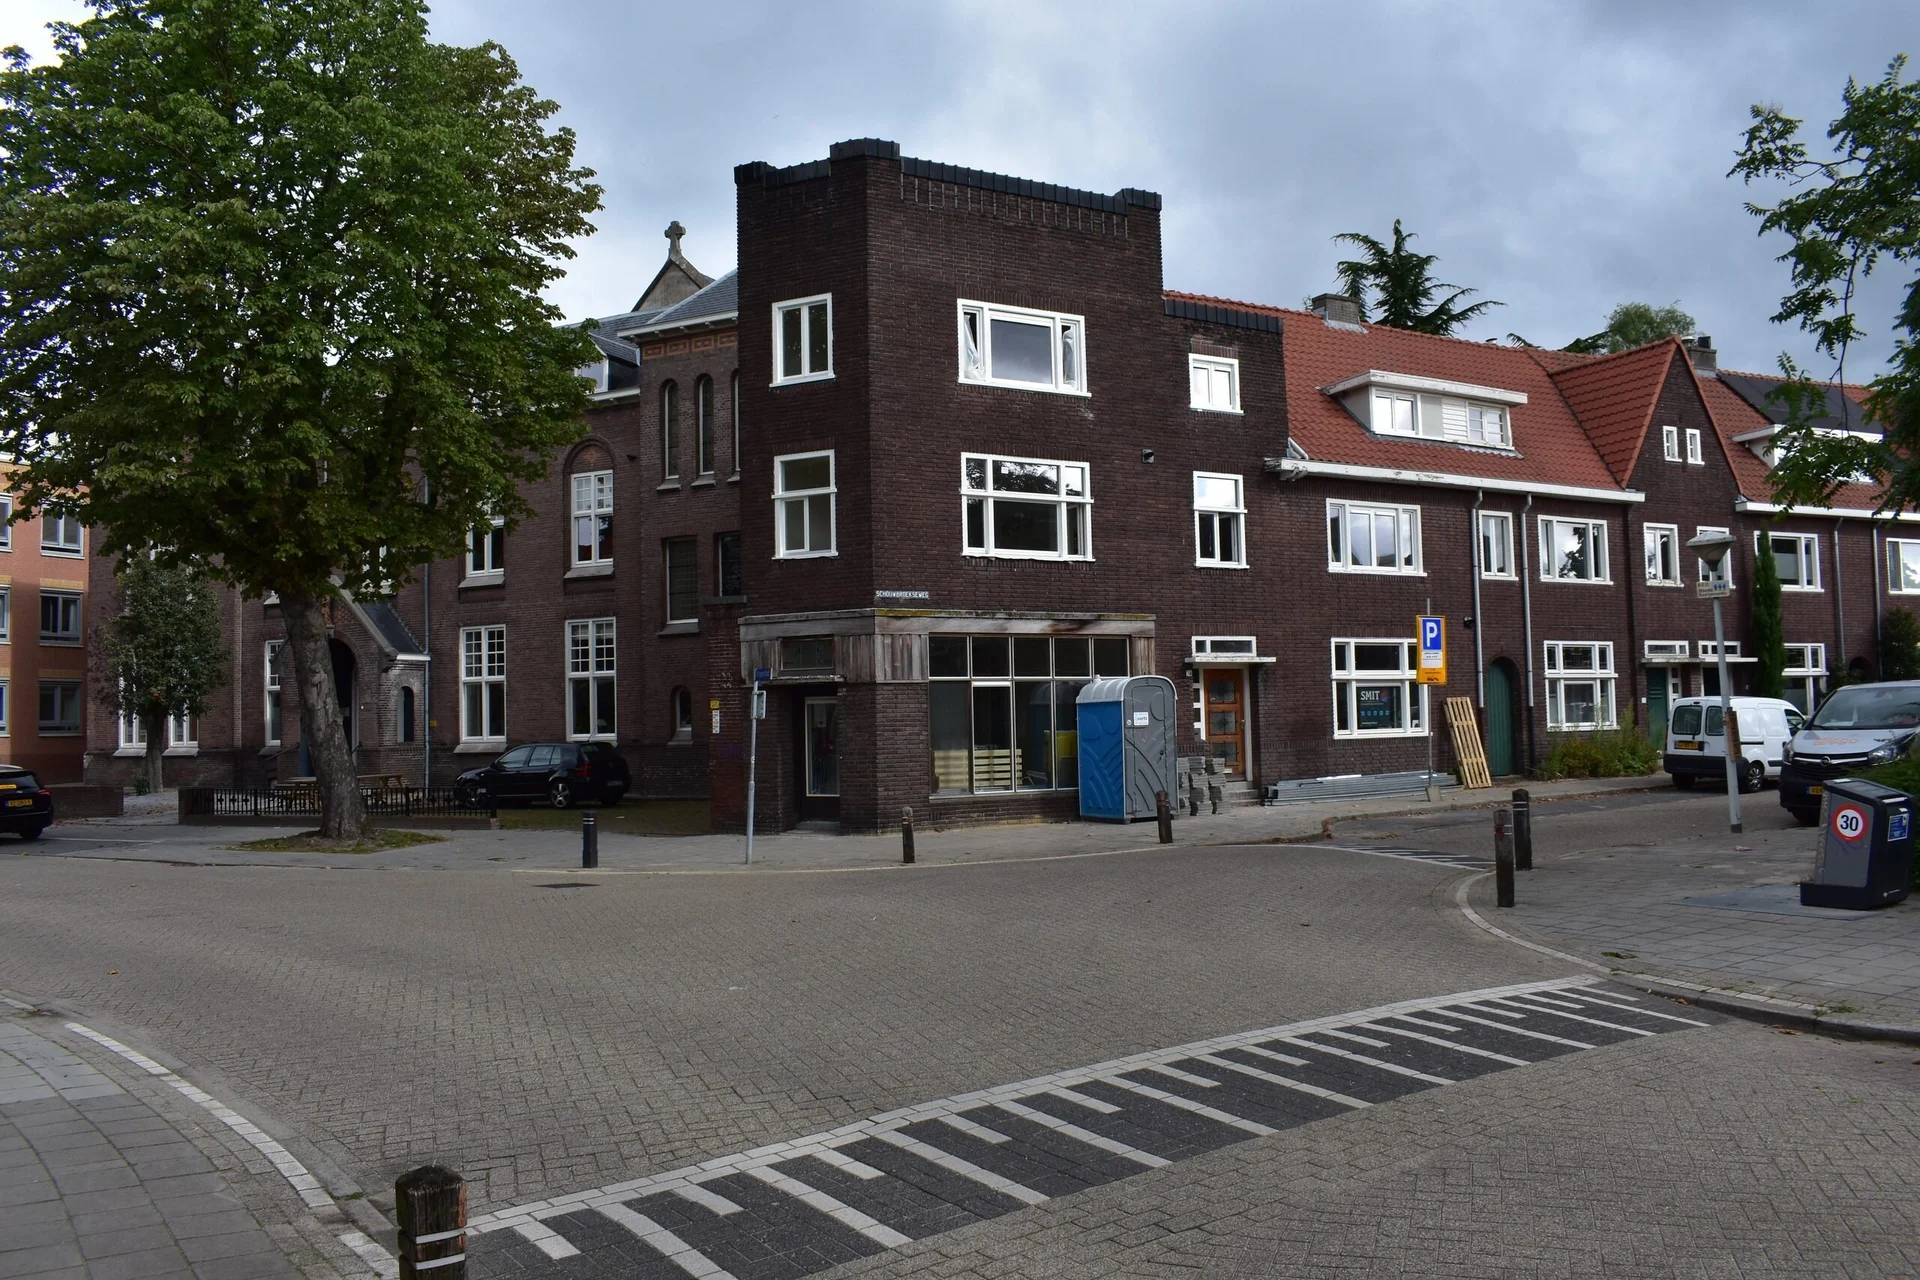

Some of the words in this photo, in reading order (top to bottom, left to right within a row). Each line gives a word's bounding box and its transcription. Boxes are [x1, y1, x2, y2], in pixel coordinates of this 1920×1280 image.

[875, 590, 929, 599] SCHOUWBROEKSEWEG
[1426, 621, 1438, 648] P
[1360, 690, 1380, 700] SMIT
[1840, 814, 1859, 832] 30
